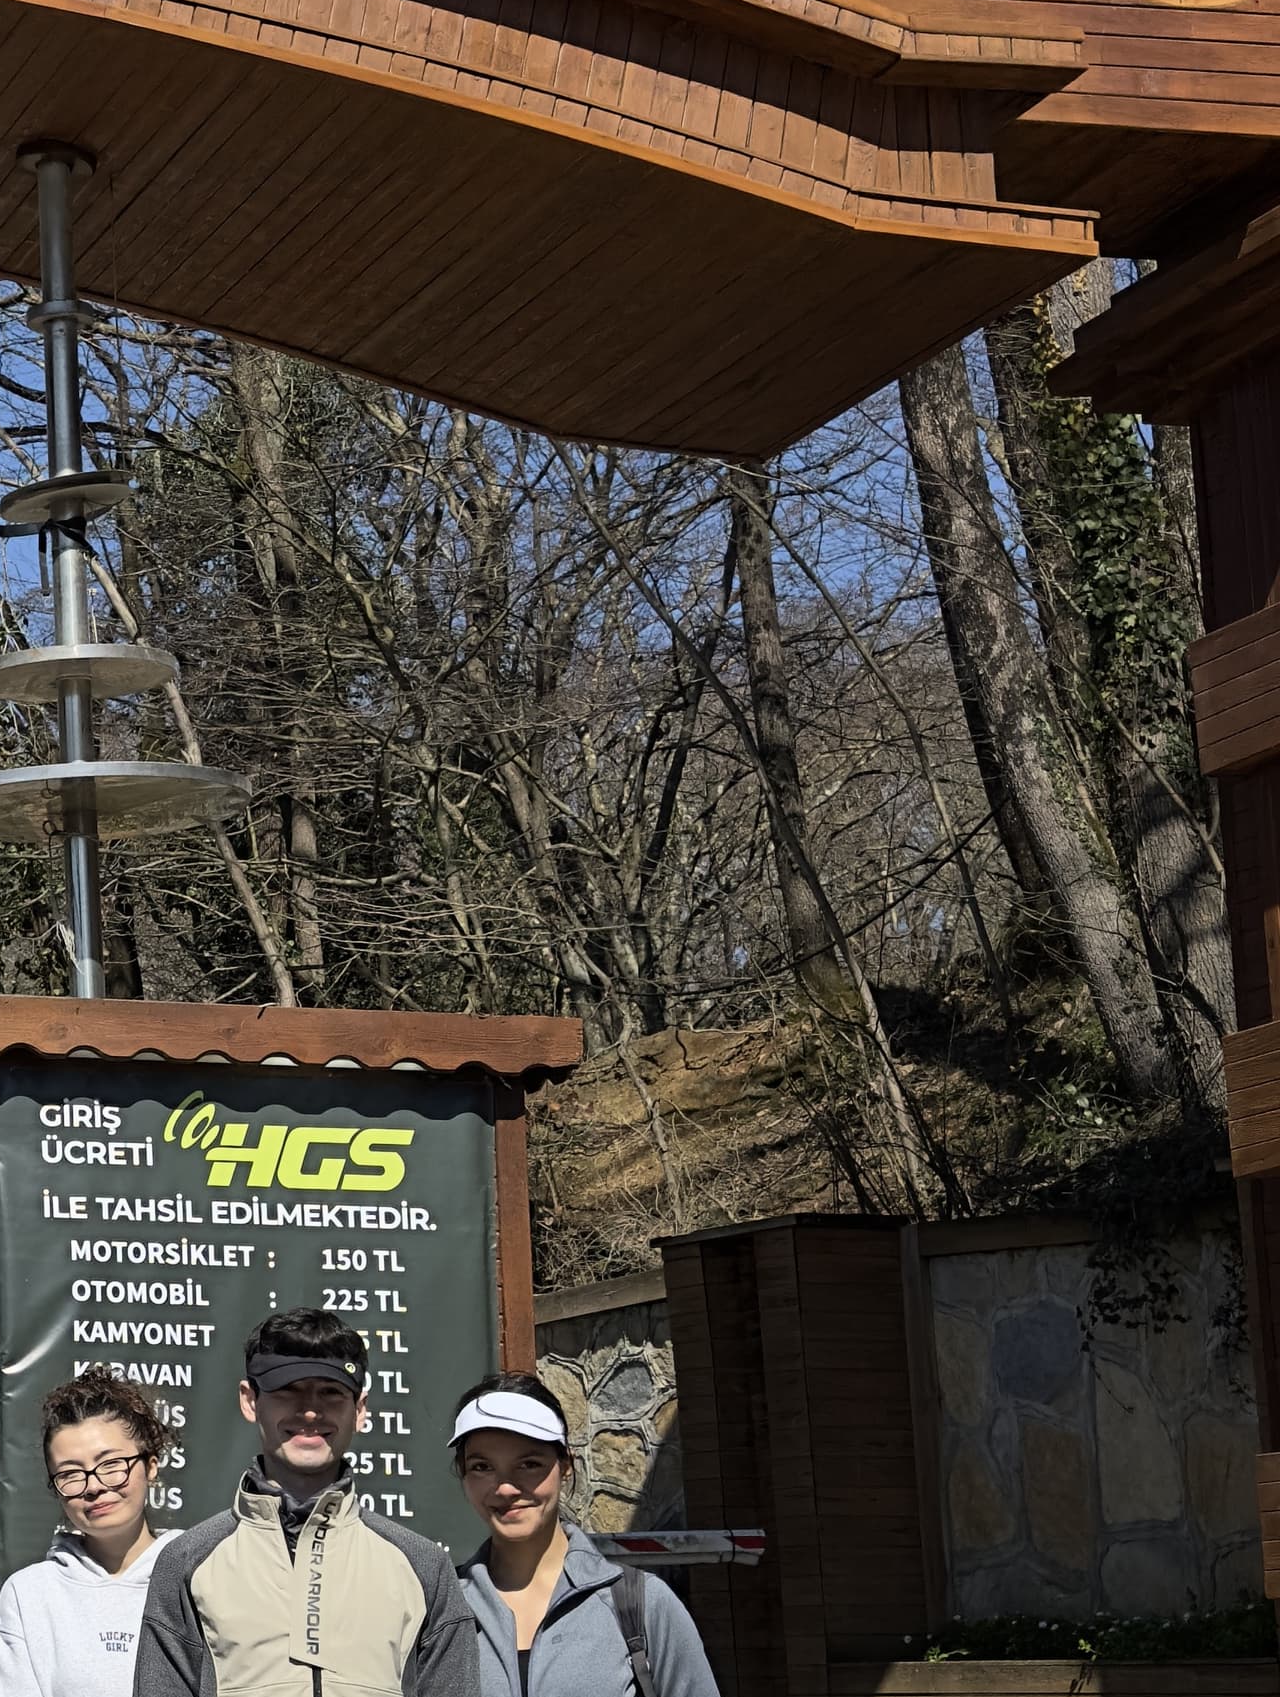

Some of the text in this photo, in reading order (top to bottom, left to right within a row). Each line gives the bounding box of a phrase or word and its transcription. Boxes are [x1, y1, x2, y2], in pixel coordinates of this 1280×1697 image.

[39, 1099, 121, 1135] GİRİŞ
[40, 1135, 154, 1167] ÜCRETİ
[205, 1122, 415, 1192] HGS
[42, 1189, 438, 1232] İLE TAHSİL EDİLMEKTEDİR.
[69, 1237, 255, 1269] MOTORSİKLET
[321, 1249, 368, 1272] 150
[372, 1250, 406, 1273] TL
[71, 1278, 211, 1308] OTOMOBİL
[322, 1289, 369, 1312] 225
[374, 1290, 408, 1314] TL
[72, 1320, 216, 1347] KAMYONET
[375, 1330, 410, 1354] TL
[377, 1371, 410, 1395] TL
[379, 1411, 412, 1436] TL
[381, 1452, 413, 1477] TL
[382, 1493, 414, 1518] TL
[305, 1501, 338, 1656] UNDER ARMOUR
[98, 1631, 135, 1643] LUCKY
[105, 1642, 129, 1653] GIRL
